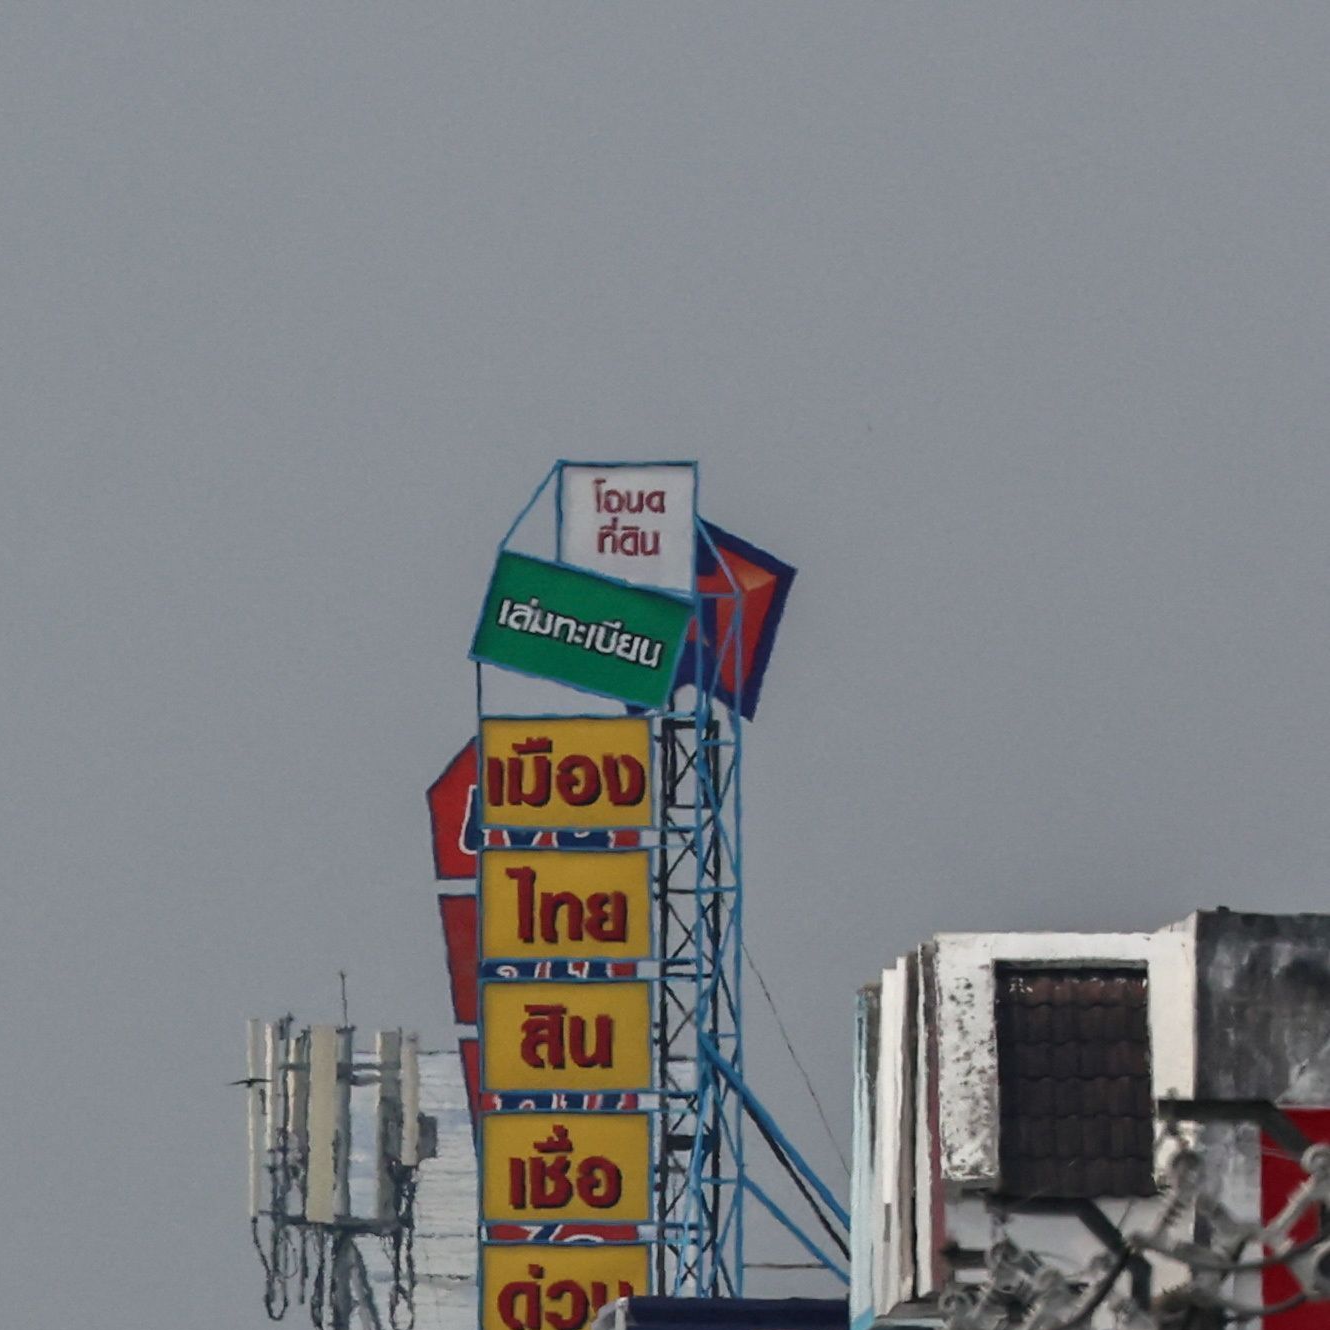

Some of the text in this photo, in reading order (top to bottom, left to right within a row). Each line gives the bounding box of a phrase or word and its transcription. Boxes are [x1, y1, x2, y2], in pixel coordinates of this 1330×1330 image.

[597, 517, 661, 556] ที่ดิน
[496, 595, 663, 668] เล่มทะเบียน
[486, 737, 647, 808] เมือง
[505, 866, 628, 944] ไทย
[520, 1004, 615, 1070] สิน
[508, 1124, 622, 1210] เชื่อ
